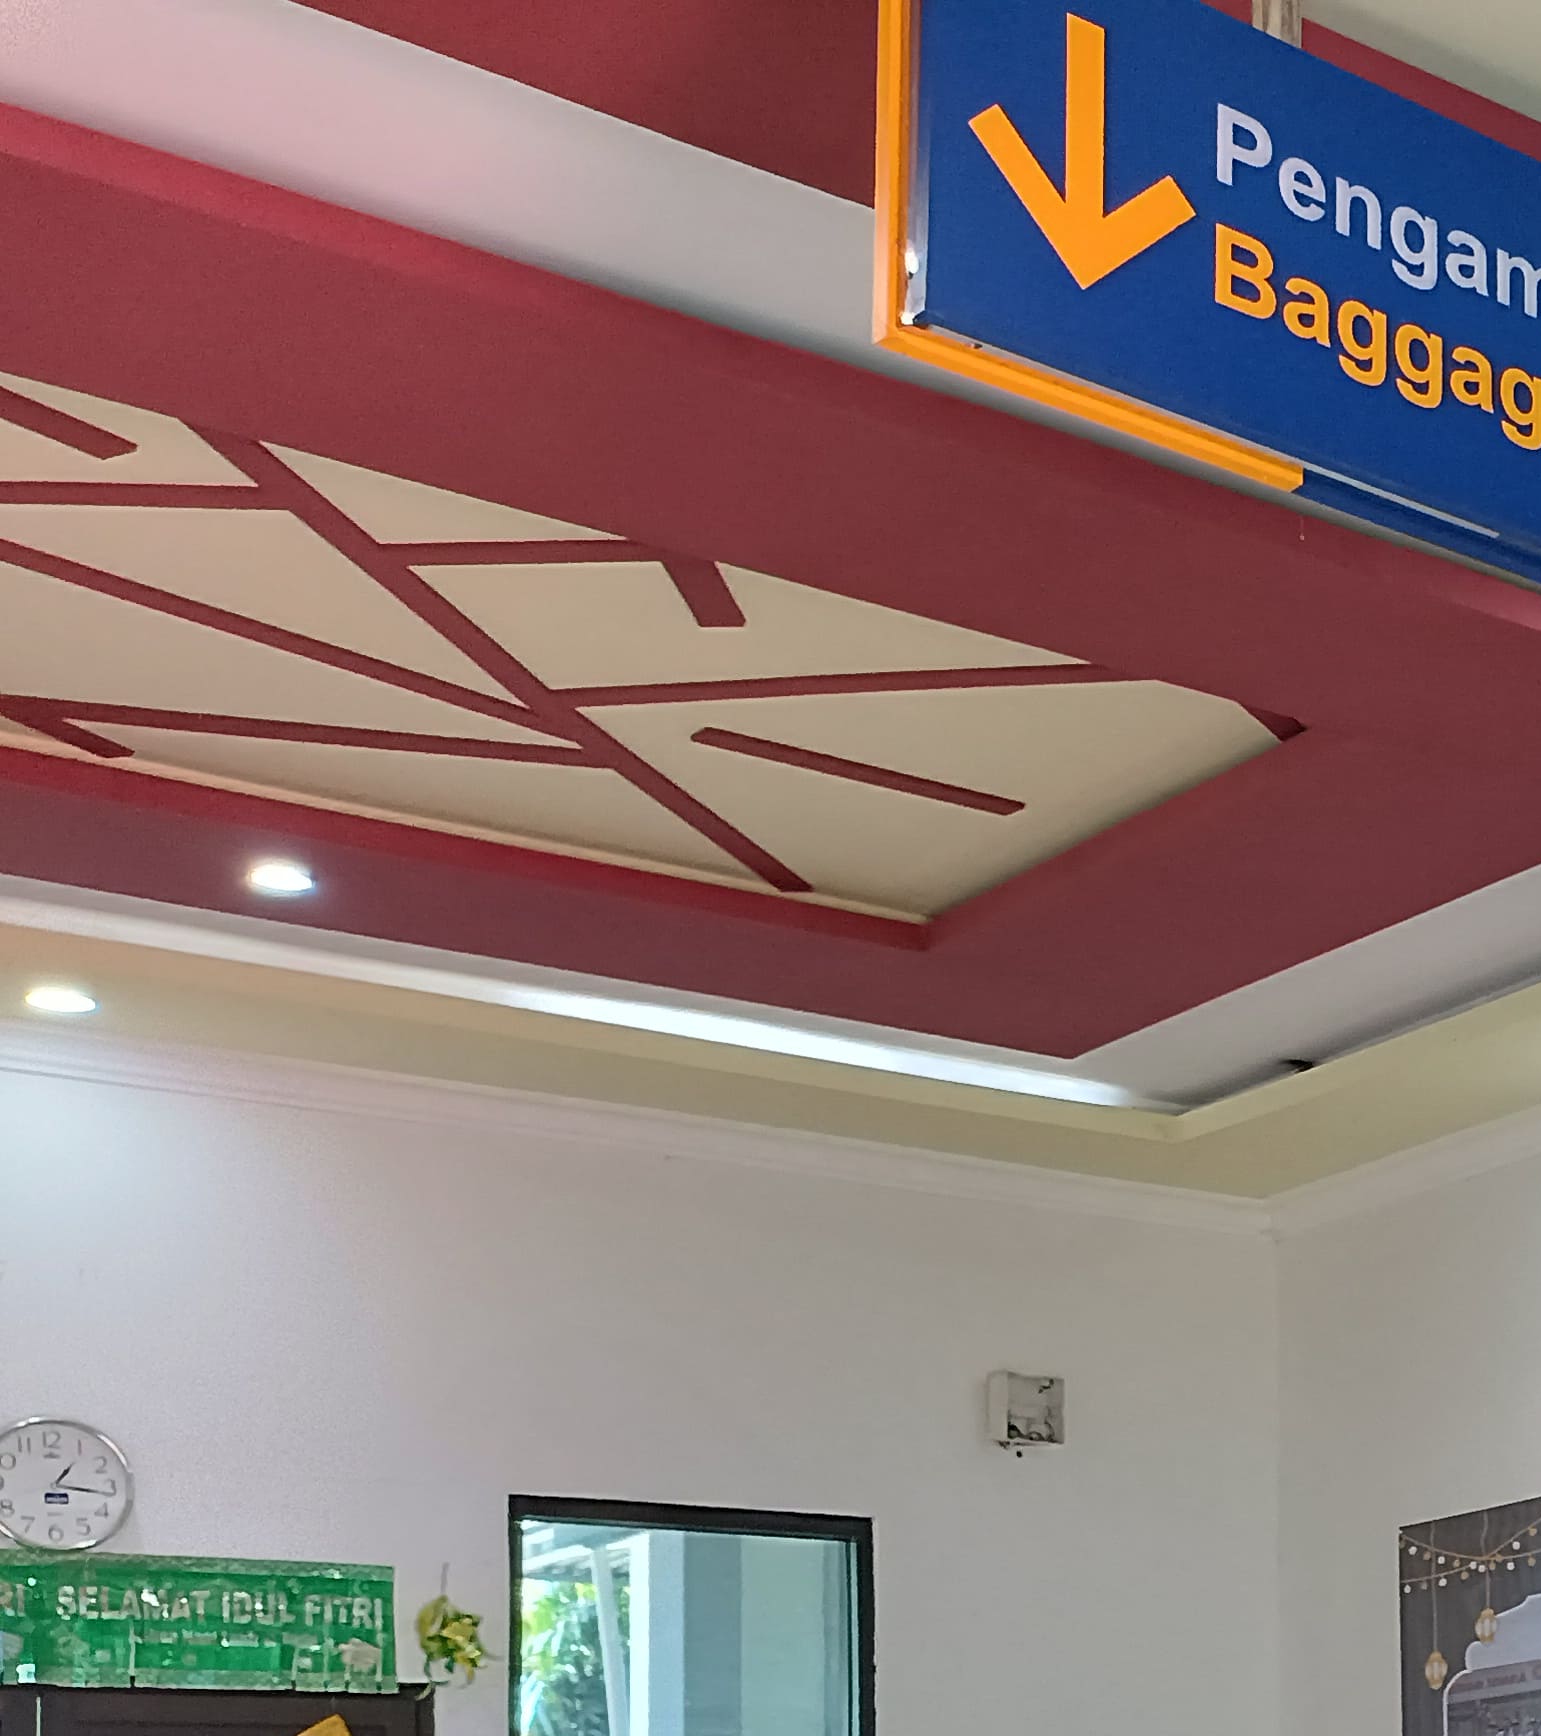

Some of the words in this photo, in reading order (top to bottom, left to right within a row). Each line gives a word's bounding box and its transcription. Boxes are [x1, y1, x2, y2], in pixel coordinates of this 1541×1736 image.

[56, 1585, 211, 1621] SELAMAT
[222, 1590, 296, 1625] IDUL
[304, 1596, 383, 1630] FITRI
